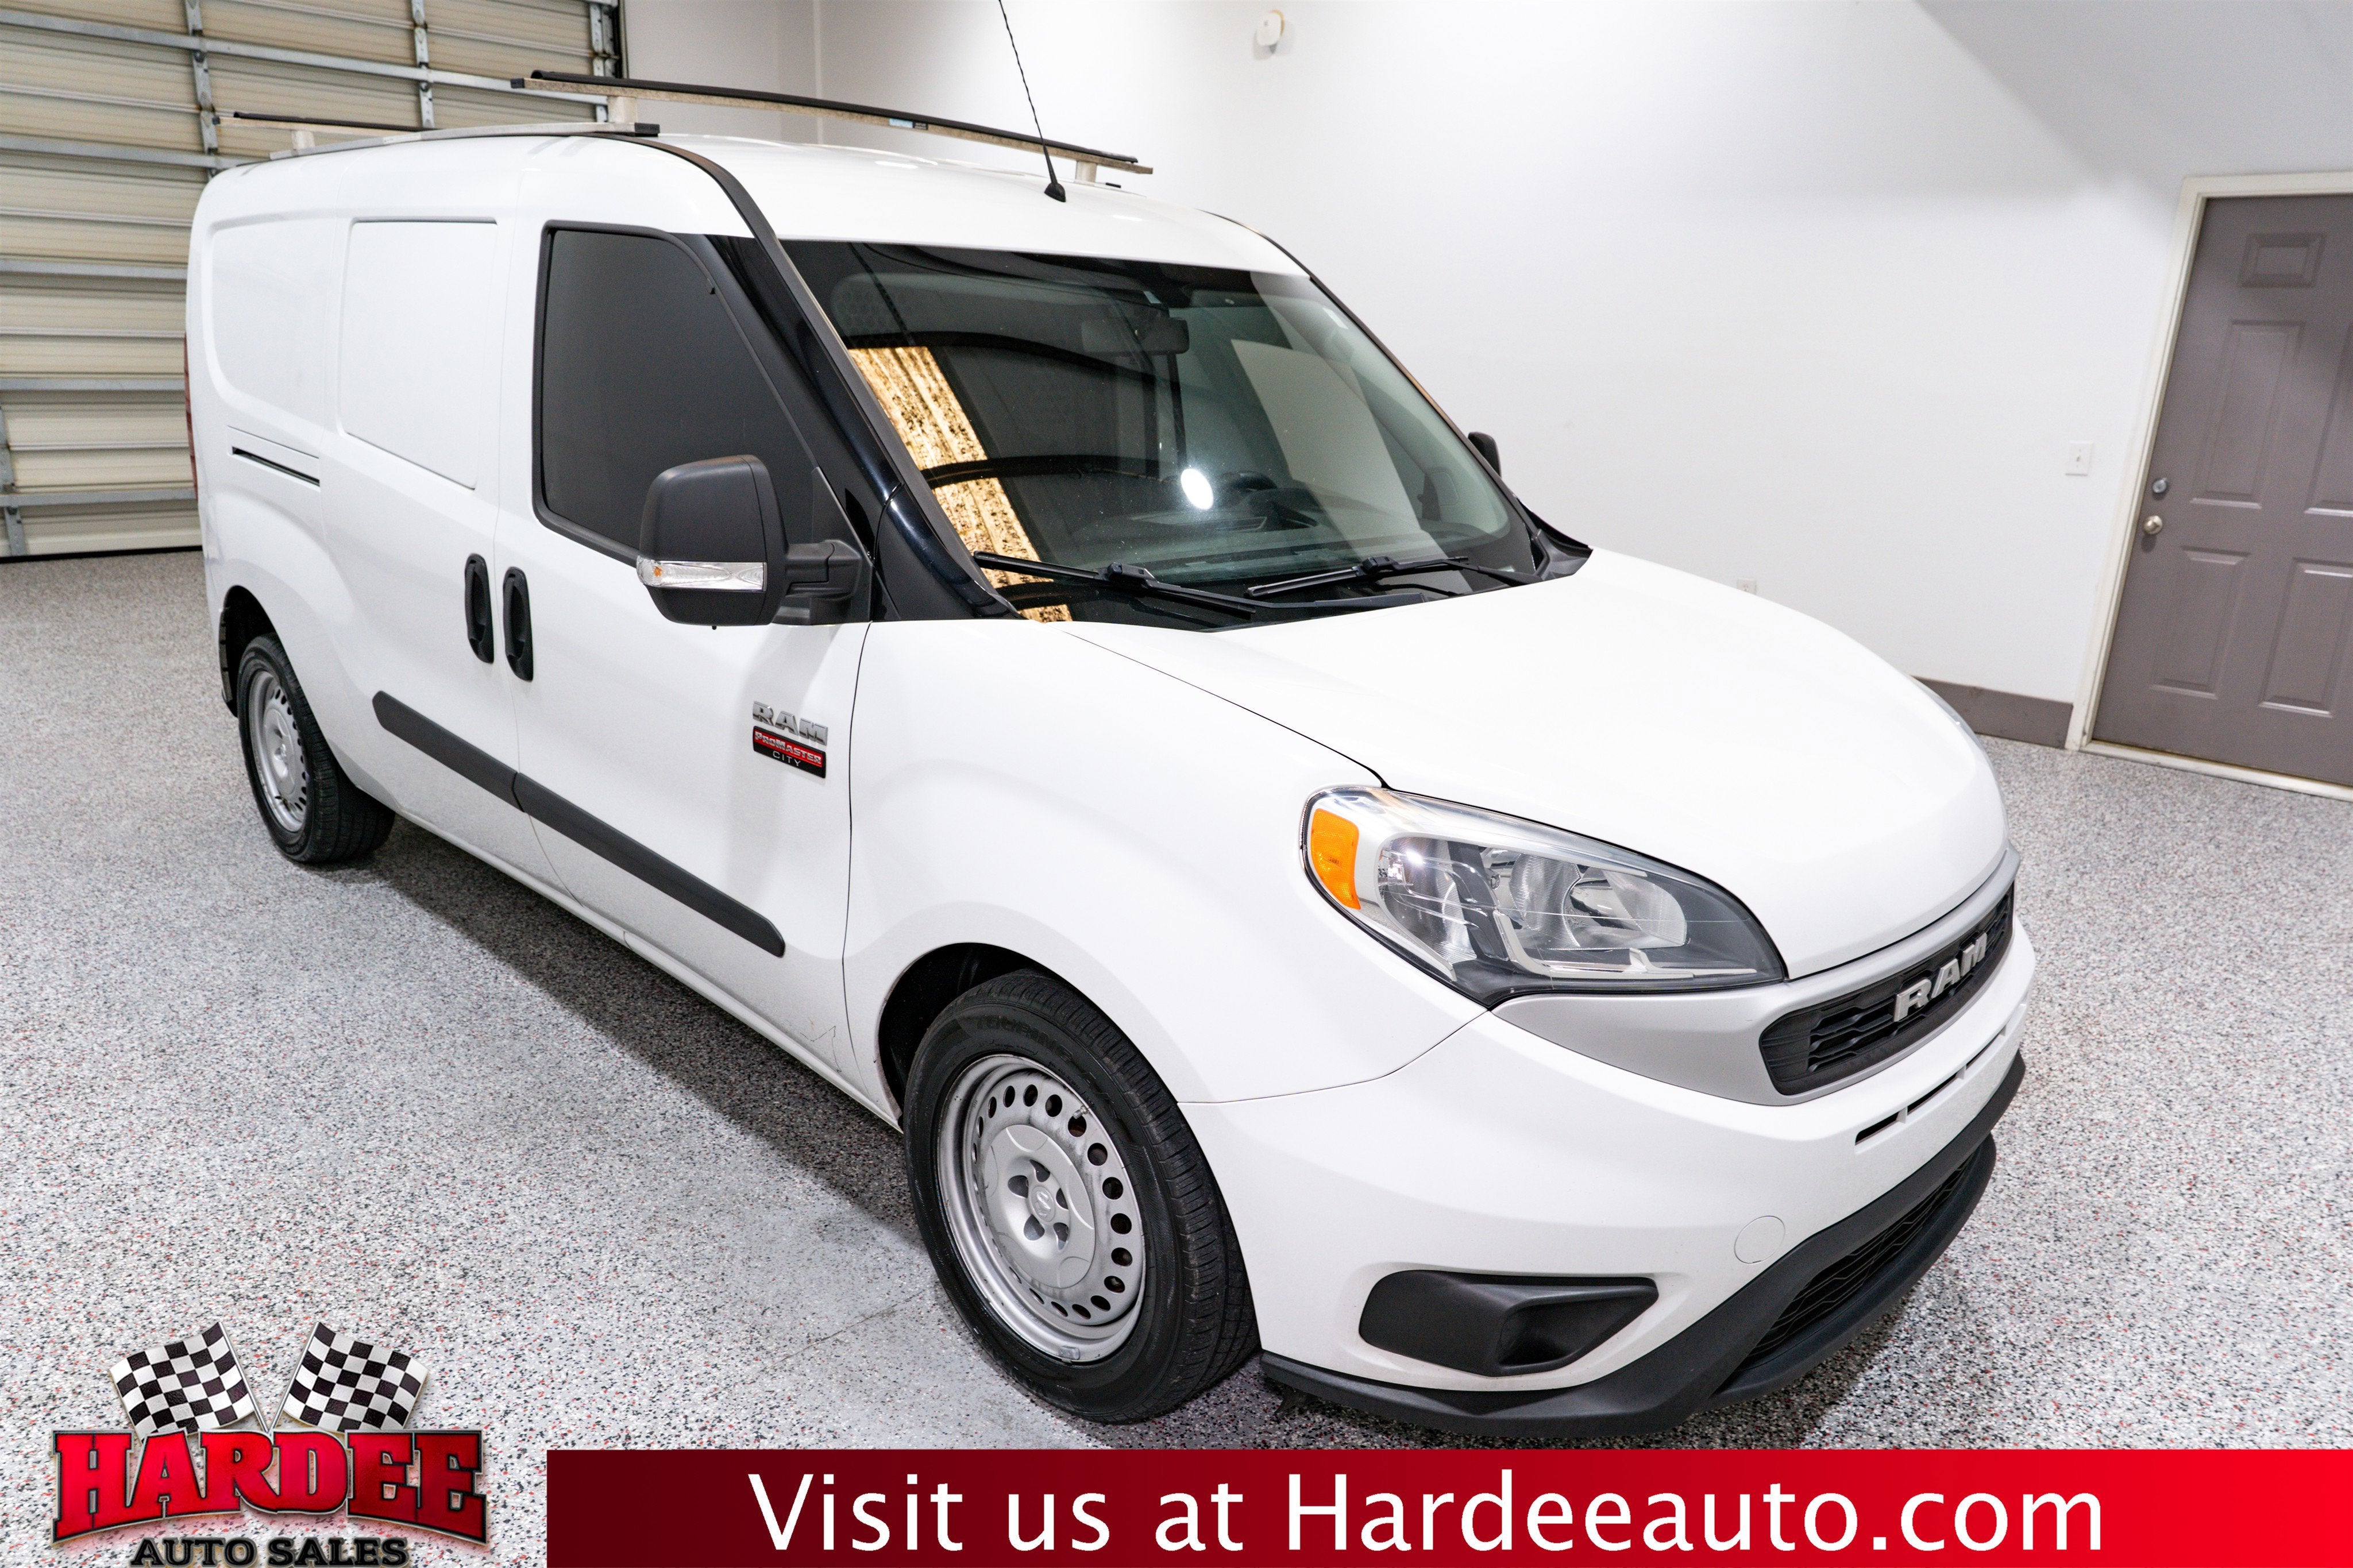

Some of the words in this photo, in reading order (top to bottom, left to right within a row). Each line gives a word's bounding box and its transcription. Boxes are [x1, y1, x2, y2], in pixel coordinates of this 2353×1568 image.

[752, 701, 828, 747] RAM
[772, 751, 801, 767] CITY
[1893, 932, 1988, 1022] RAM
